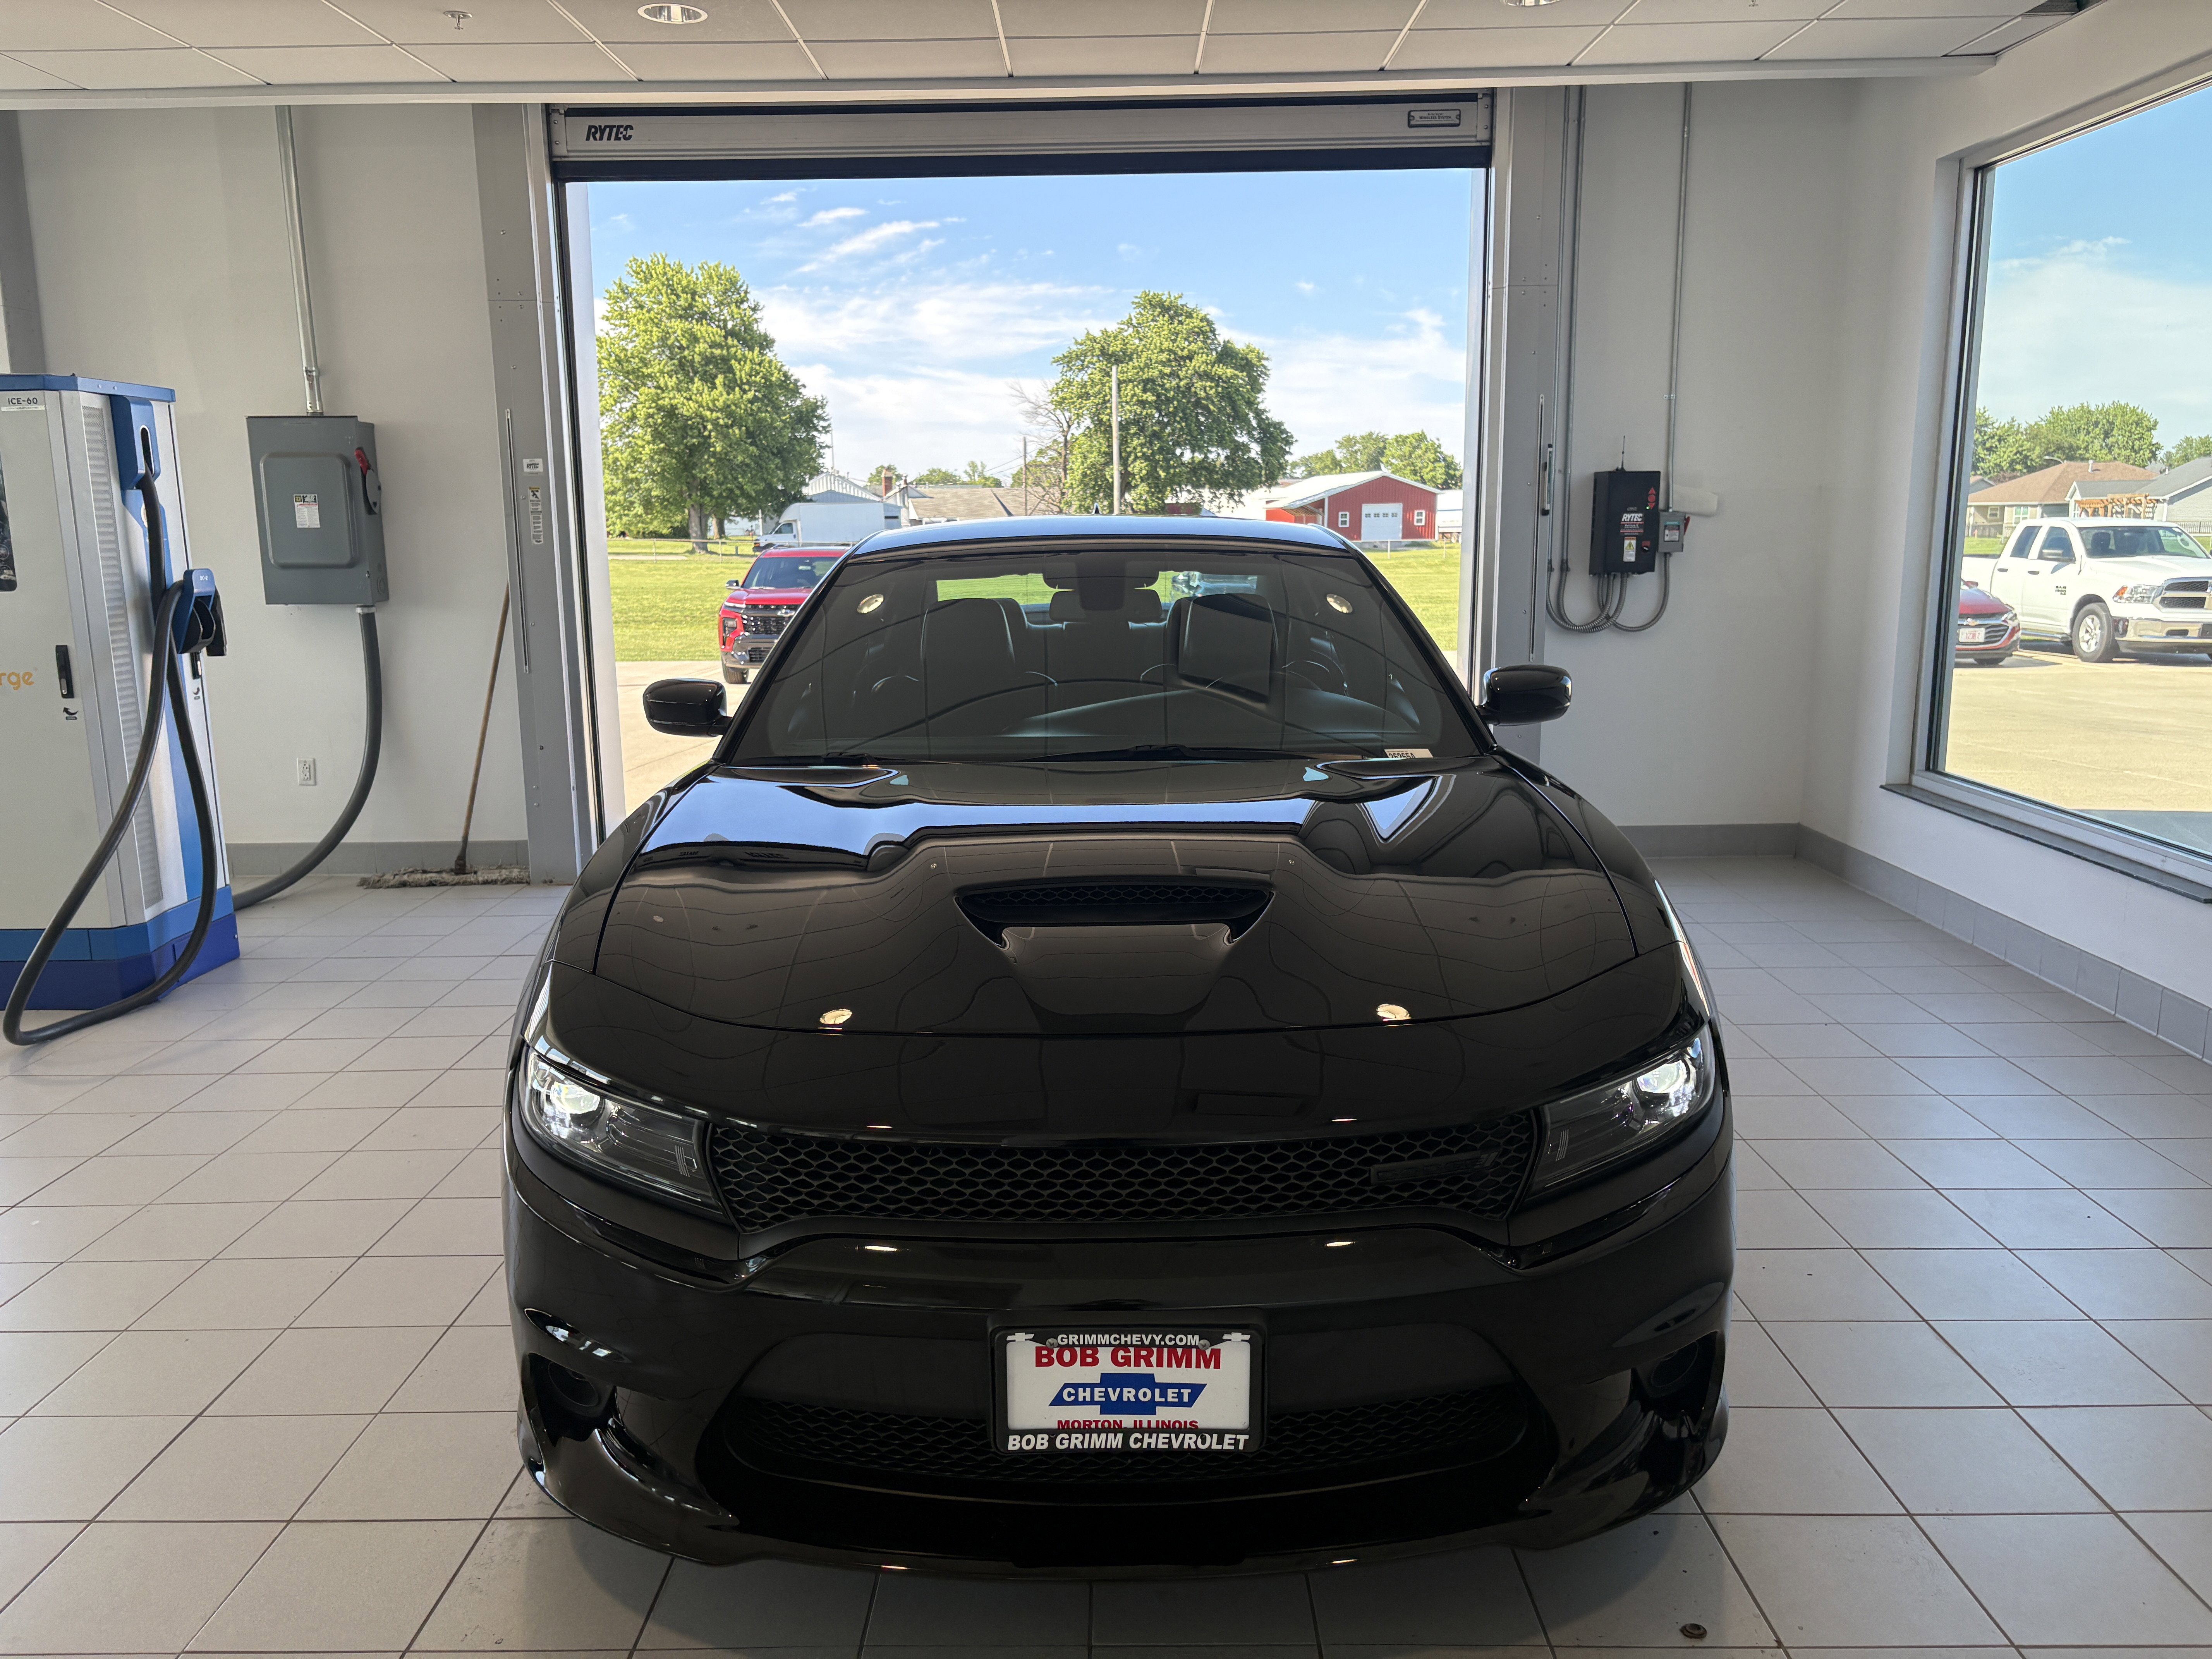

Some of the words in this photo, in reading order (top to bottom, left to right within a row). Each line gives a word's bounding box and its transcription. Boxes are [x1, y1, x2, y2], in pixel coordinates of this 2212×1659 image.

[586, 125, 634, 141] RYTEC
[1621, 513, 1643, 522] RYTEC
[1057, 1334, 1200, 1346] GRIMMCHEVY.COM
[1035, 1346, 1099, 1367] BOB
[1110, 1347, 1221, 1369] GRIMM
[1063, 1388, 1191, 1402] CHEVROLET
[1057, 1420, 1127, 1429] MORTON
[1133, 1420, 1199, 1429] ILLINOIS
[1008, 1434, 1049, 1450] BOB
[1055, 1433, 1123, 1449] GRIMM
[1129, 1433, 1249, 1450] CHEVROLET
